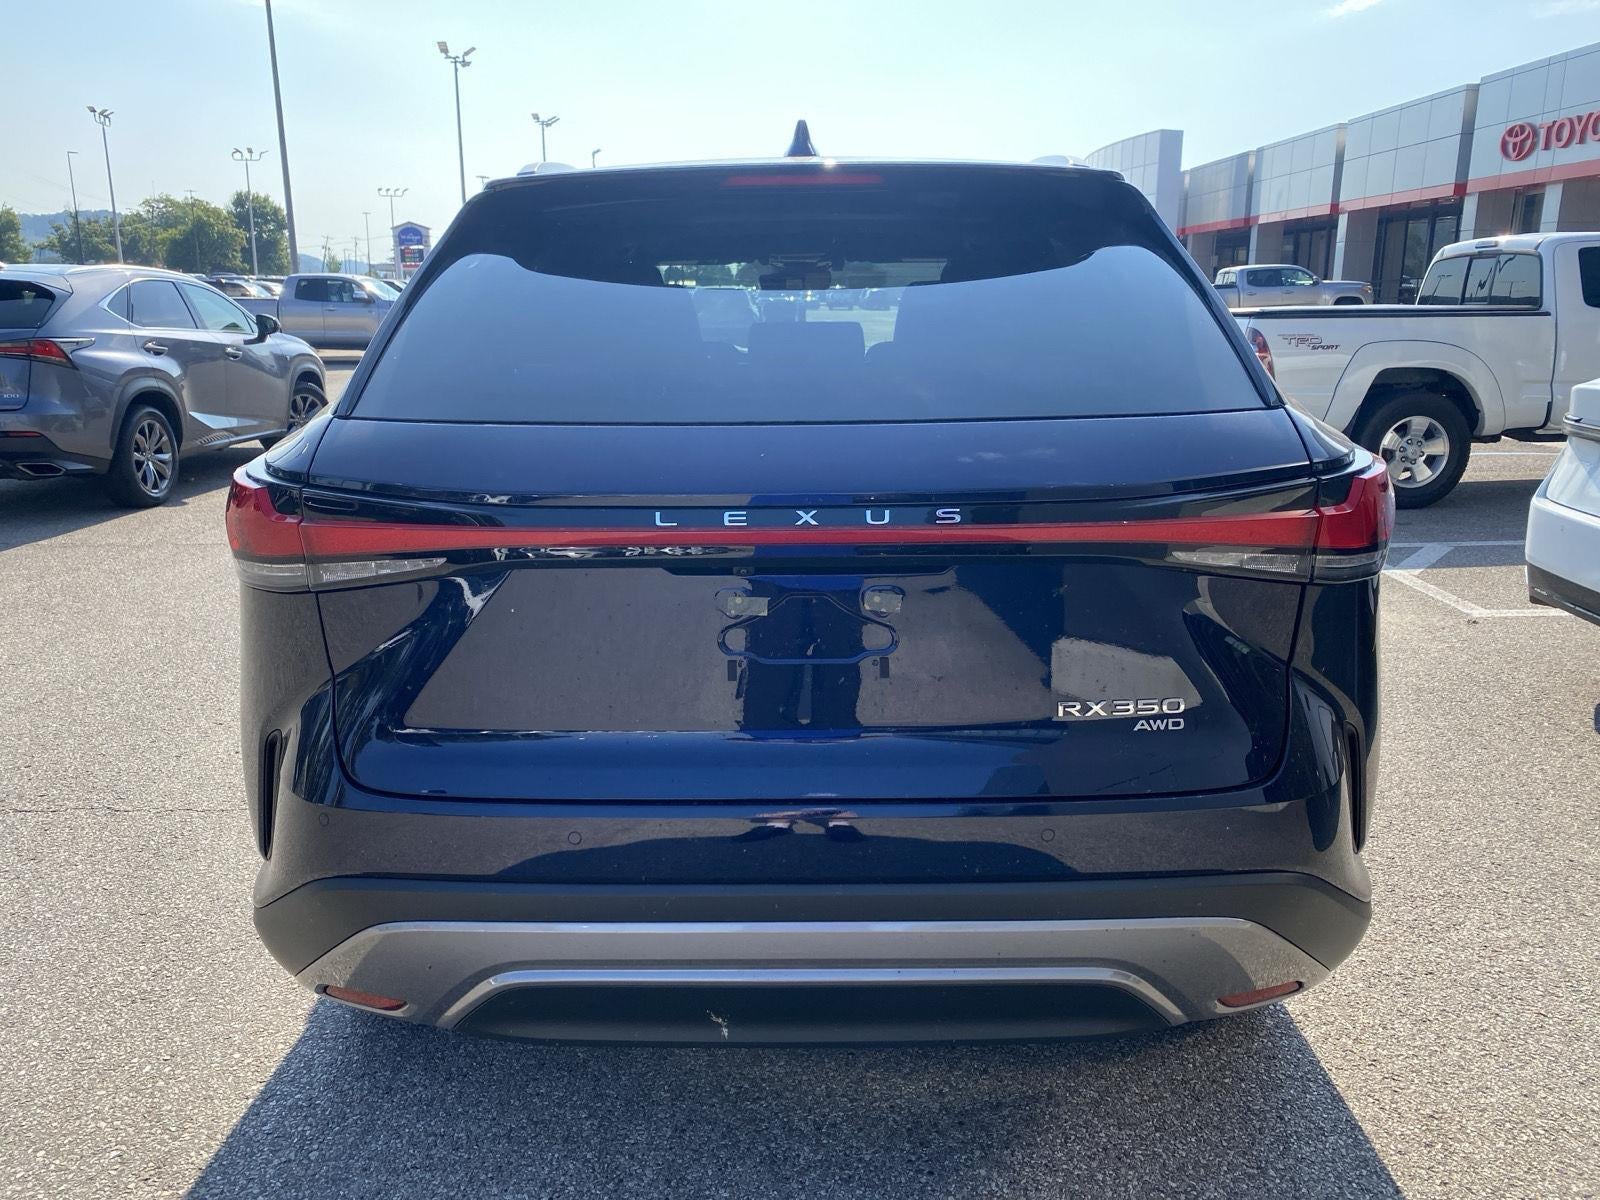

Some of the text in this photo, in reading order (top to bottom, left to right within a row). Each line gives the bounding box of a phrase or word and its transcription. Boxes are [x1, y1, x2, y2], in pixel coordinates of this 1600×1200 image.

[1282, 336, 1322, 347] TRD
[655, 508, 961, 526] LEXUS
[1133, 718, 1185, 731] AWD
